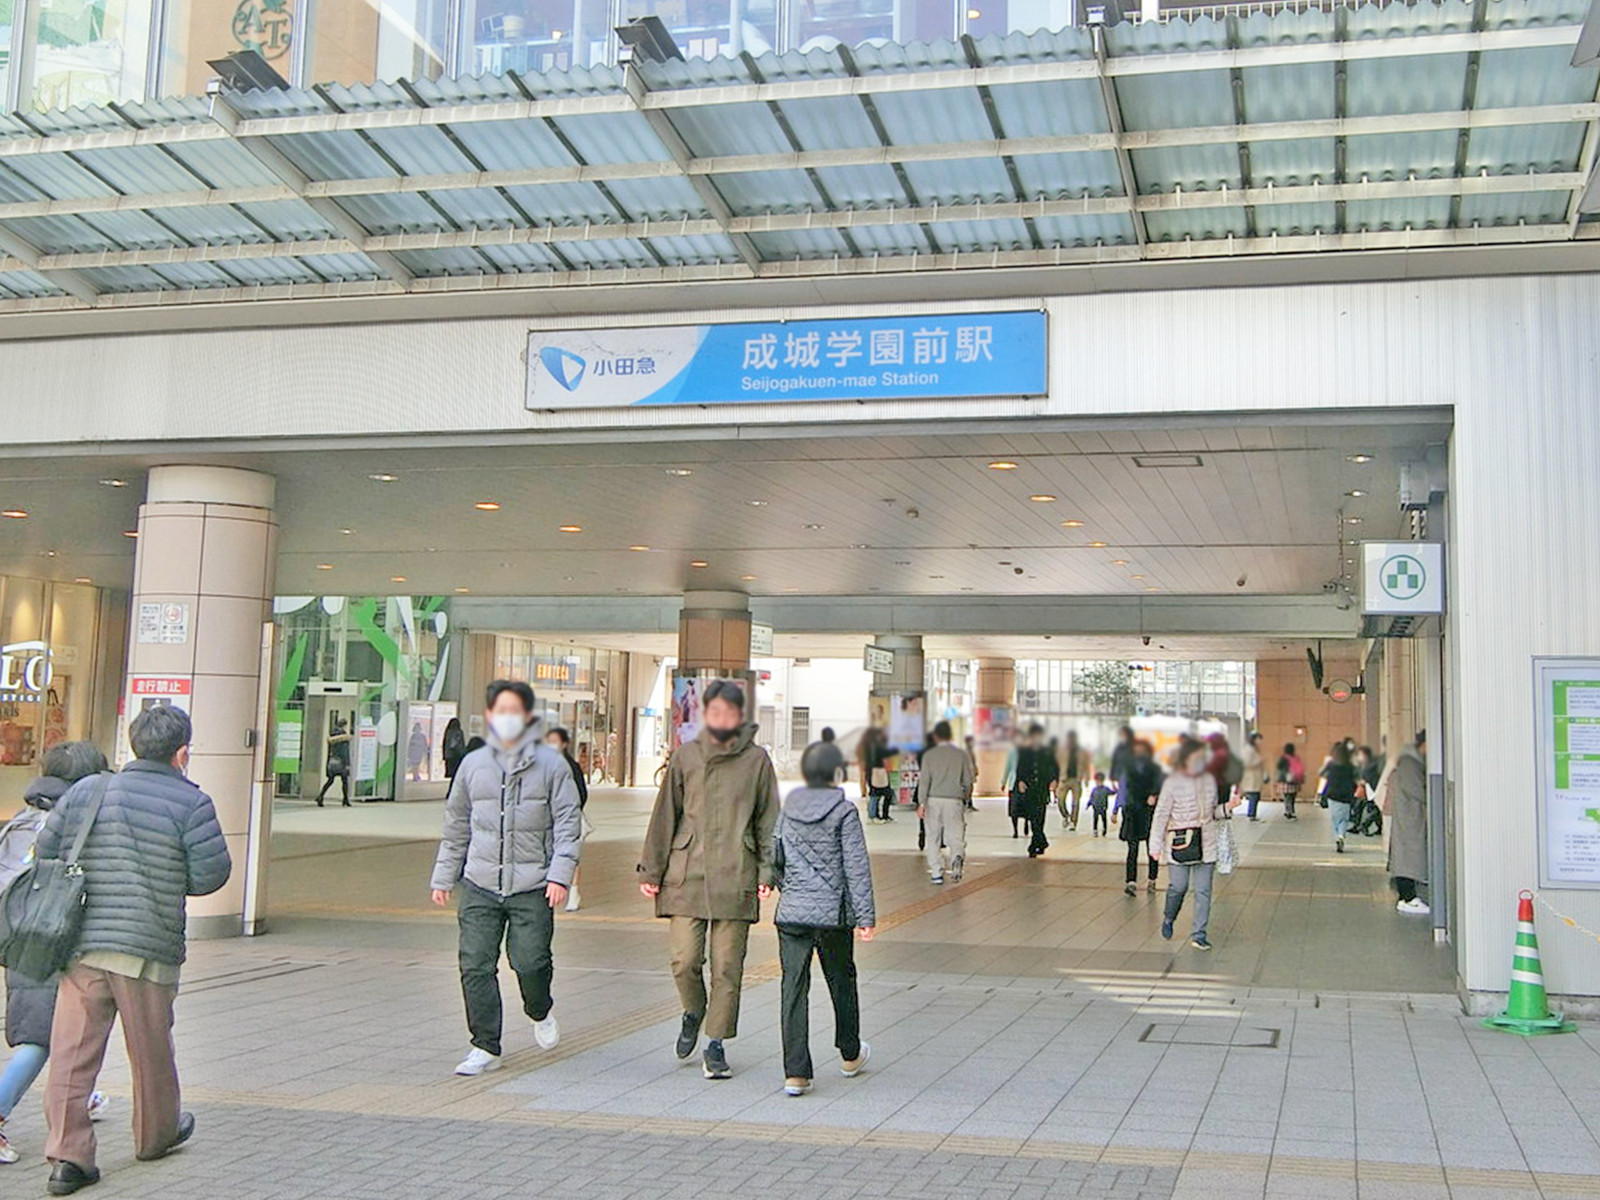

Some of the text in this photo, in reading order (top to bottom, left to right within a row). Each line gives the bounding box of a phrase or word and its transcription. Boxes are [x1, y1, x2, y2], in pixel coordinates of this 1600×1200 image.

[742, 326, 993, 369] 成城学園前駅
[592, 356, 657, 376] 小田急
[741, 370, 939, 394] Seijogakuen-mae Station
[136, 680, 181, 693] 走行禁止
